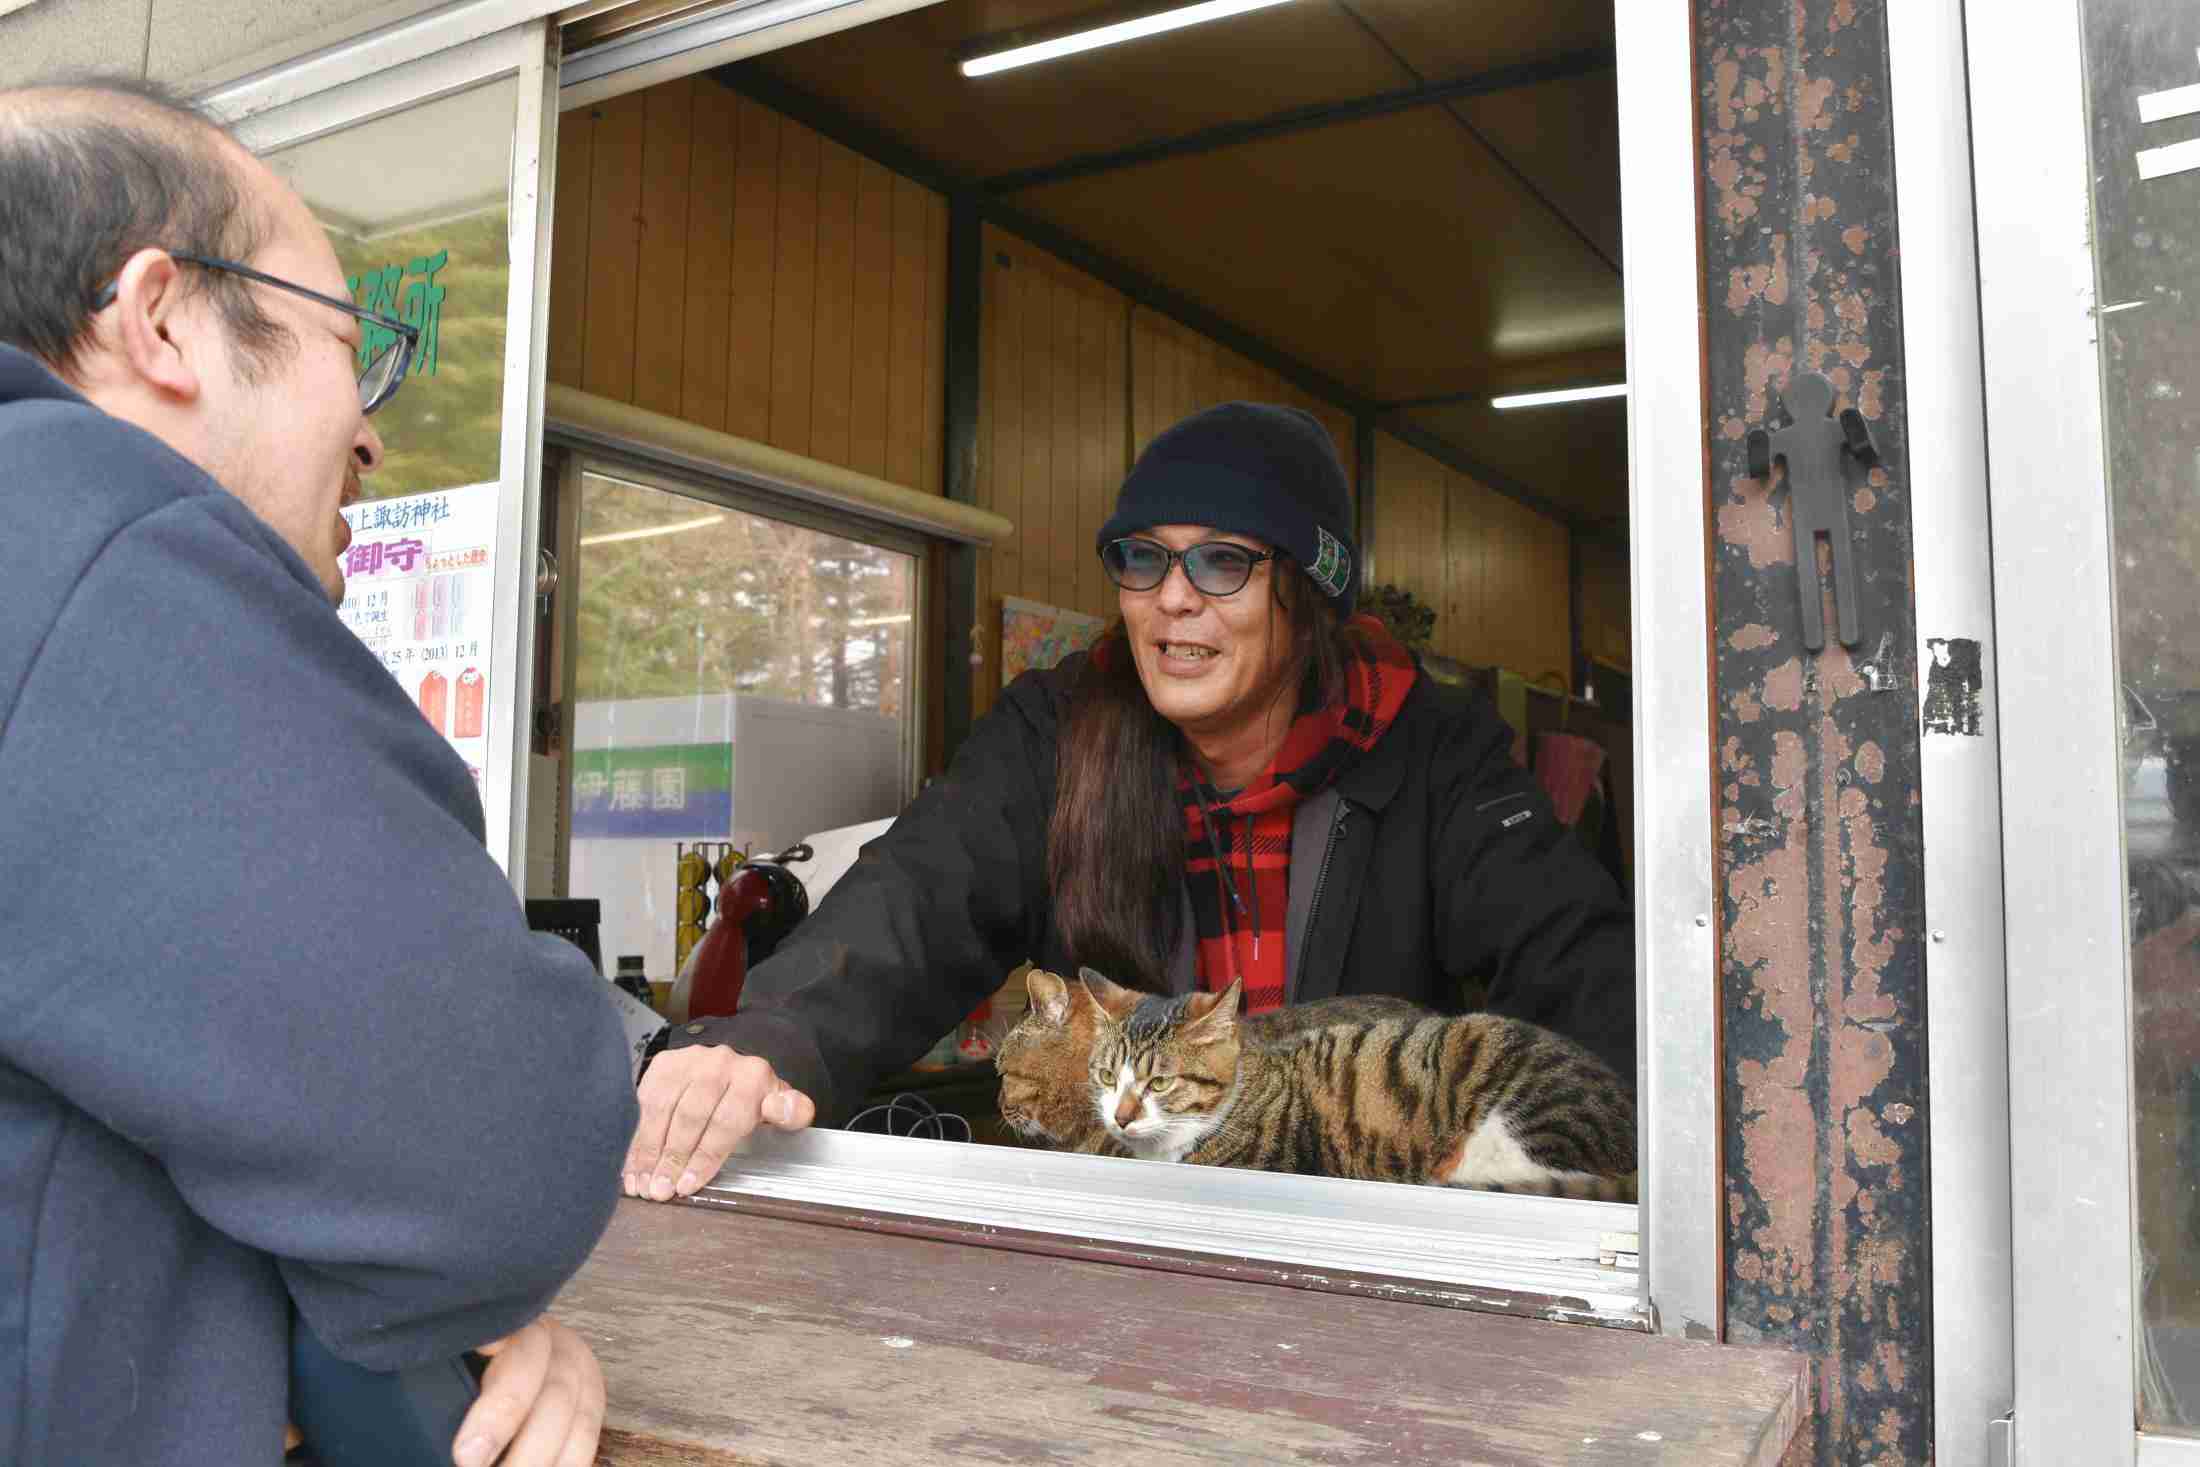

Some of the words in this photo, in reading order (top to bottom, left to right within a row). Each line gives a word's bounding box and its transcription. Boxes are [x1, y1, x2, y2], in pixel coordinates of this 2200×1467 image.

[345, 496, 451, 531] 上諏訪神社
[346, 538, 423, 577] 御守
[573, 767, 686, 813] 伊藤園
